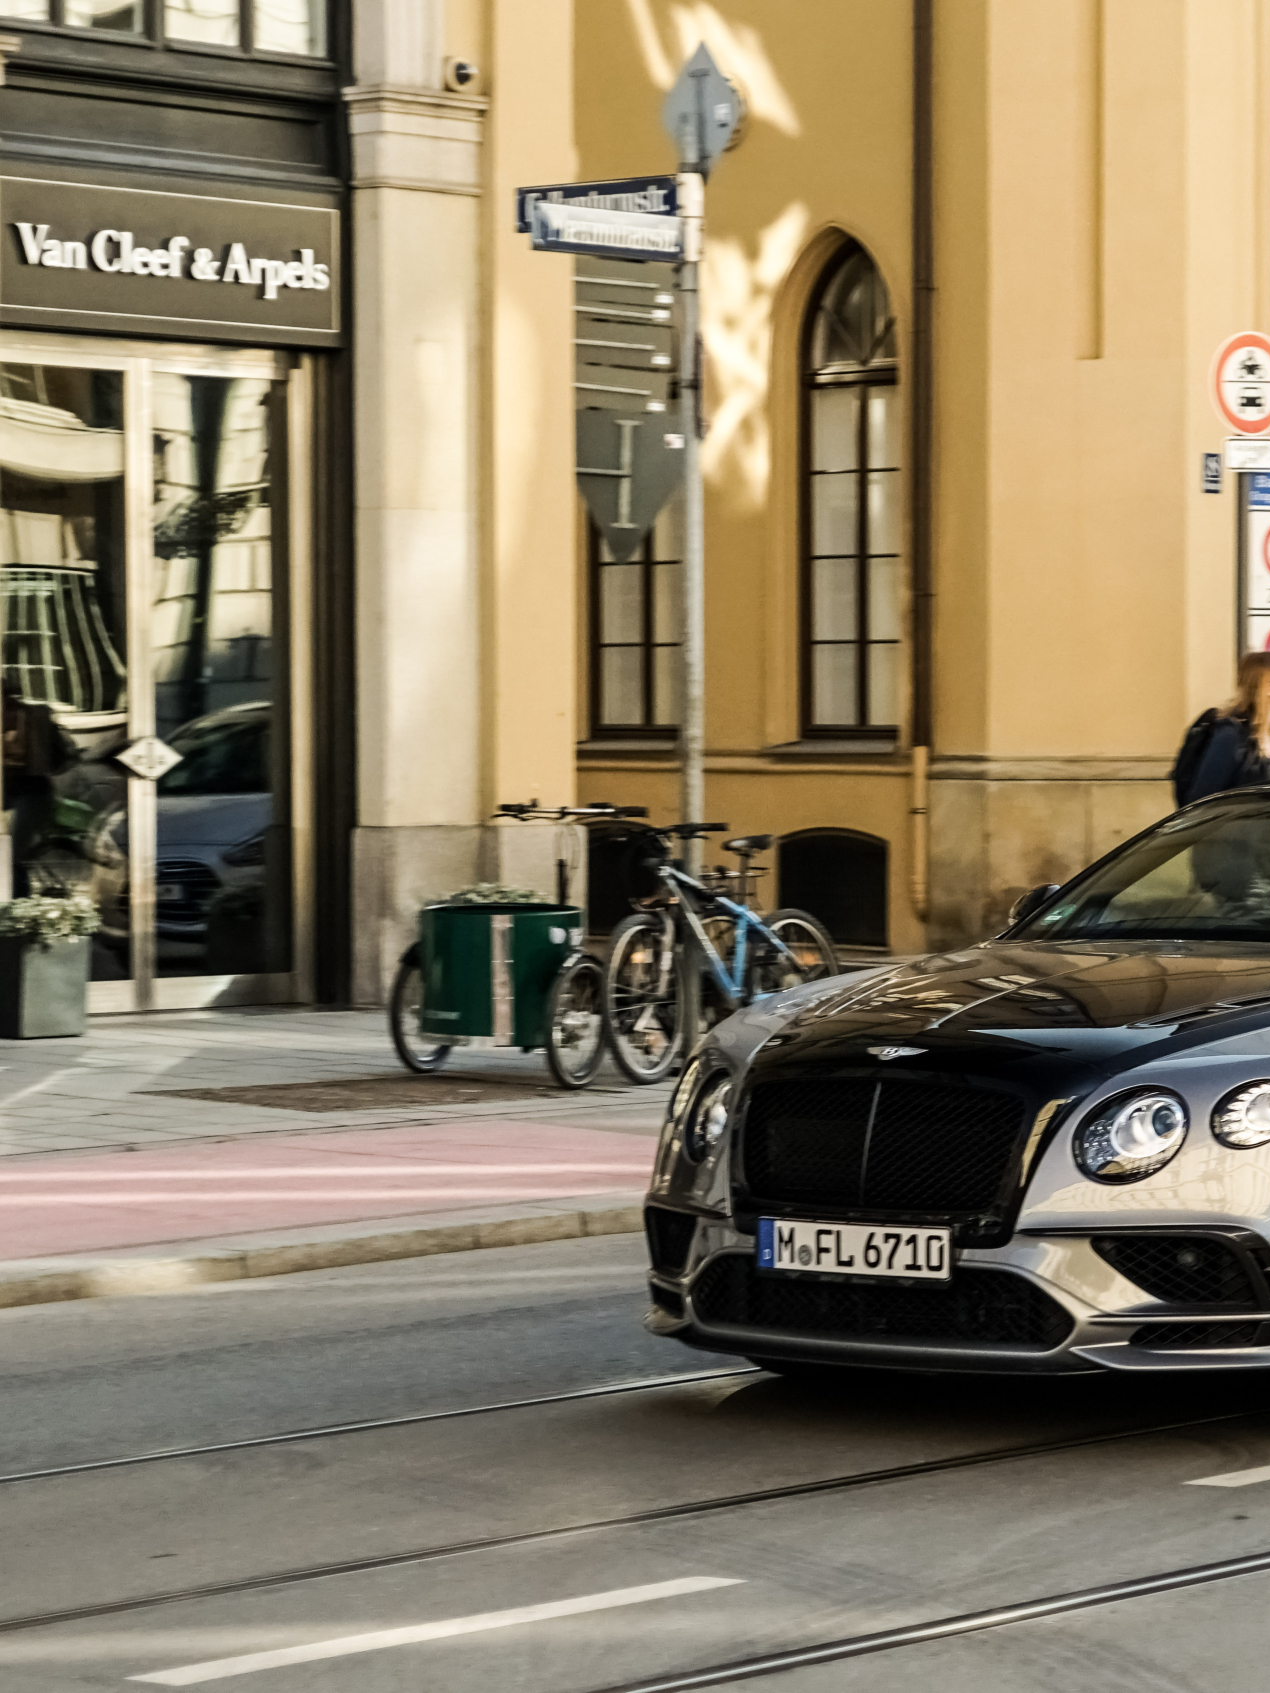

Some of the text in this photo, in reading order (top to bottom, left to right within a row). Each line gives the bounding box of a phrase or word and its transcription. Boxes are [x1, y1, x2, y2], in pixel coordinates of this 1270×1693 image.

[14, 222, 331, 300] Van Cleef & Arpels
[777, 1226, 796, 1264] M
[815, 1229, 855, 1267] FL
[863, 1232, 945, 1272] 6710
